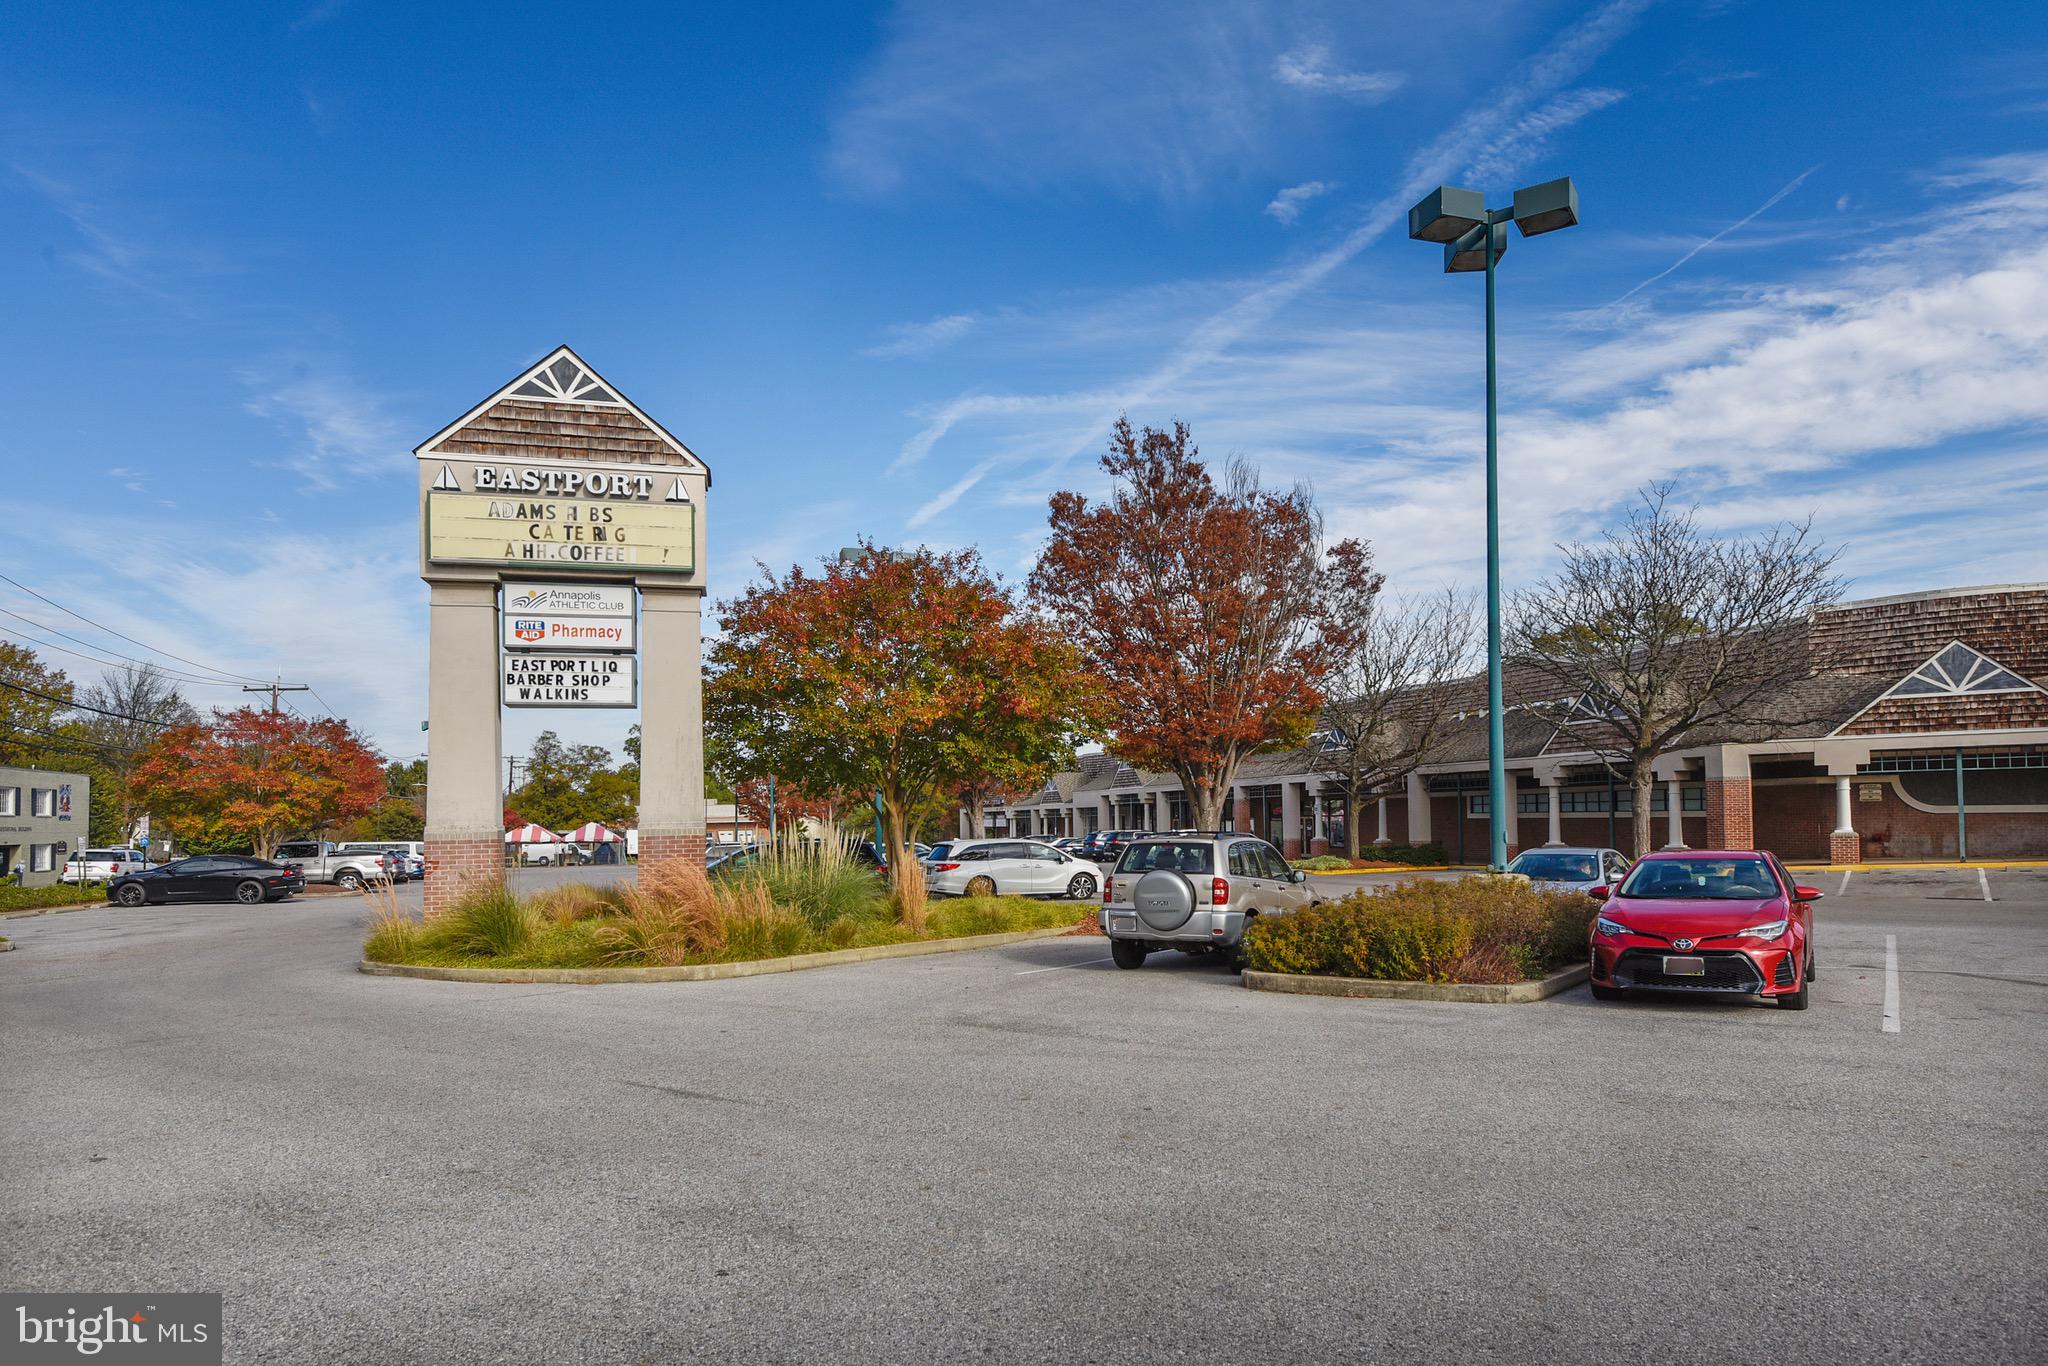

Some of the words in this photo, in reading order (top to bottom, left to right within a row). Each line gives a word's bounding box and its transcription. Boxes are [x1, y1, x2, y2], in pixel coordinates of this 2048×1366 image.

[474, 466, 653, 498] EASTPORT
[488, 501, 556, 520] ADAMS
[549, 590, 601, 602] Annapolis
[549, 601, 596, 609] ATHLETIC
[598, 602, 624, 610] CLUB
[518, 621, 542, 630] RITE
[520, 631, 540, 639] AID
[552, 624, 622, 641] Pharmacy
[507, 674, 564, 686] BARBER
[572, 675, 611, 686] SHOP
